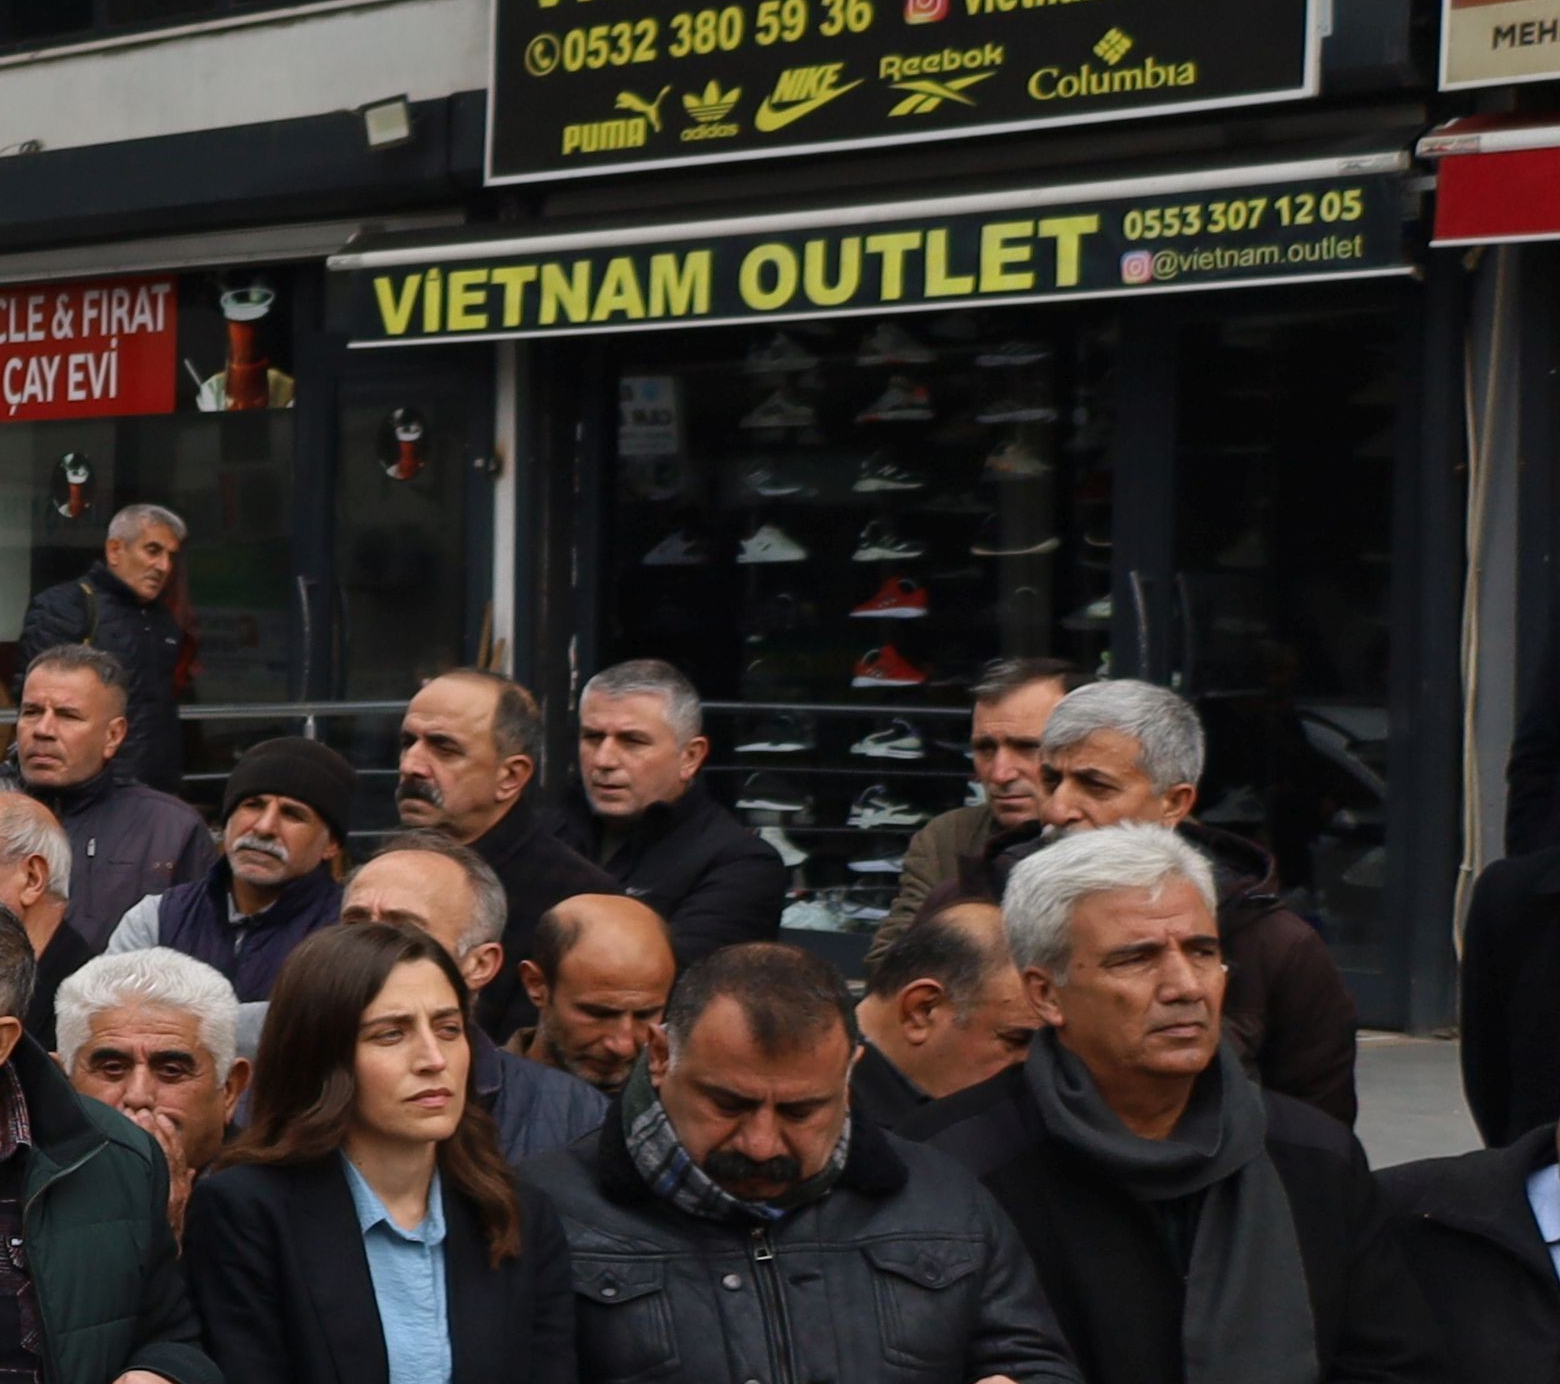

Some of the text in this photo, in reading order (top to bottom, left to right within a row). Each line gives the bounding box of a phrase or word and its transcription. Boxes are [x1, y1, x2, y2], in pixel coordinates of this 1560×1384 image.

[562, 18, 656, 73] 0532
[670, 8, 744, 59] 380
[879, 42, 1005, 83] Reebok
[775, 62, 846, 103] NIKE
[1027, 57, 1196, 101] Columbia
[562, 117, 648, 155] PUMA
[681, 121, 739, 142] adidas
[1123, 189, 1363, 241] 0553 307 12 05
[373, 214, 1102, 337] VİETNAM OUTLET
[1152, 233, 1364, 281] @vietnam.outlet
[53, 292, 75, 341] &
[82, 282, 172, 337] FIRAT
[3, 336, 118, 416] ÇAY EVİ
